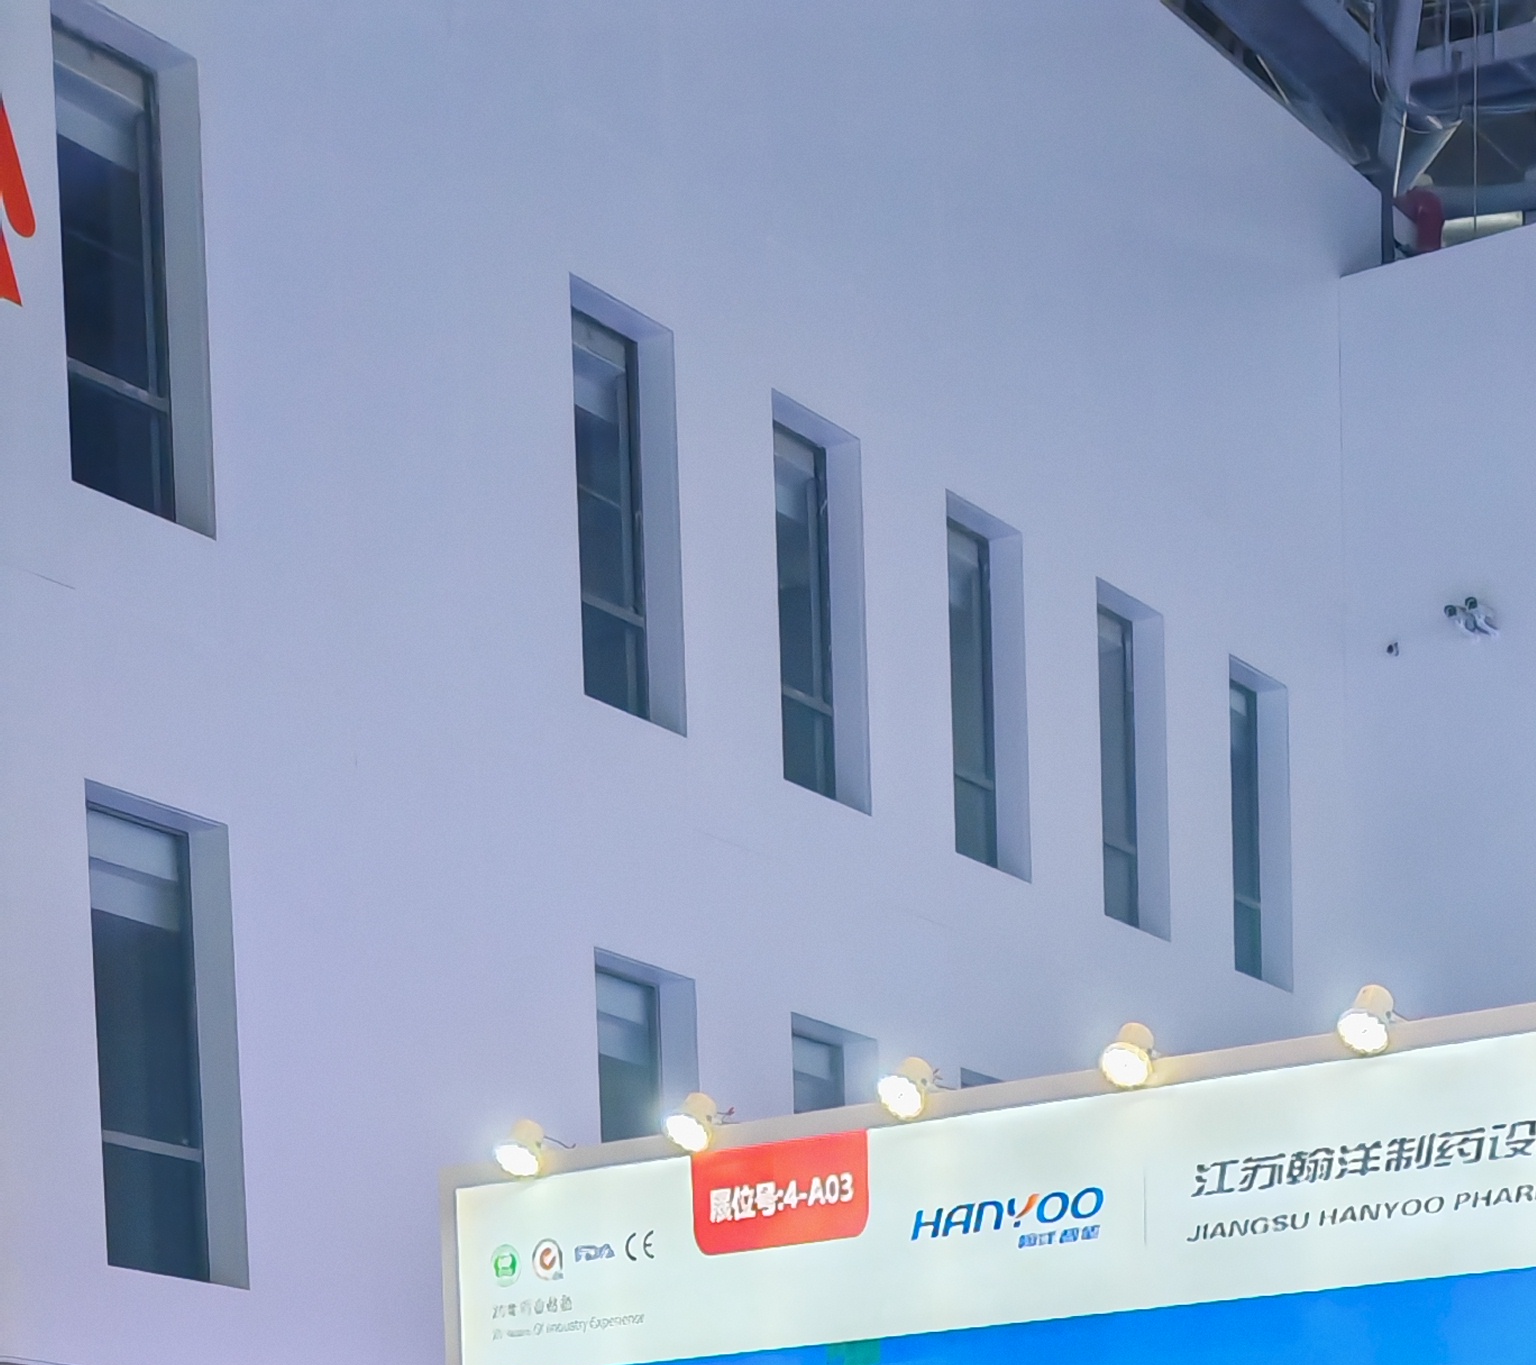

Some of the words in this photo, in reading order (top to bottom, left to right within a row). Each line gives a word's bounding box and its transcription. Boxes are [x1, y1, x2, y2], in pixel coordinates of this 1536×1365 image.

[910, 1187, 1105, 1242] HANYOO
[1187, 1211, 1310, 1242] JIANGSU
[1319, 1196, 1445, 1227] HANYOO
[624, 1230, 656, 1262] CE
